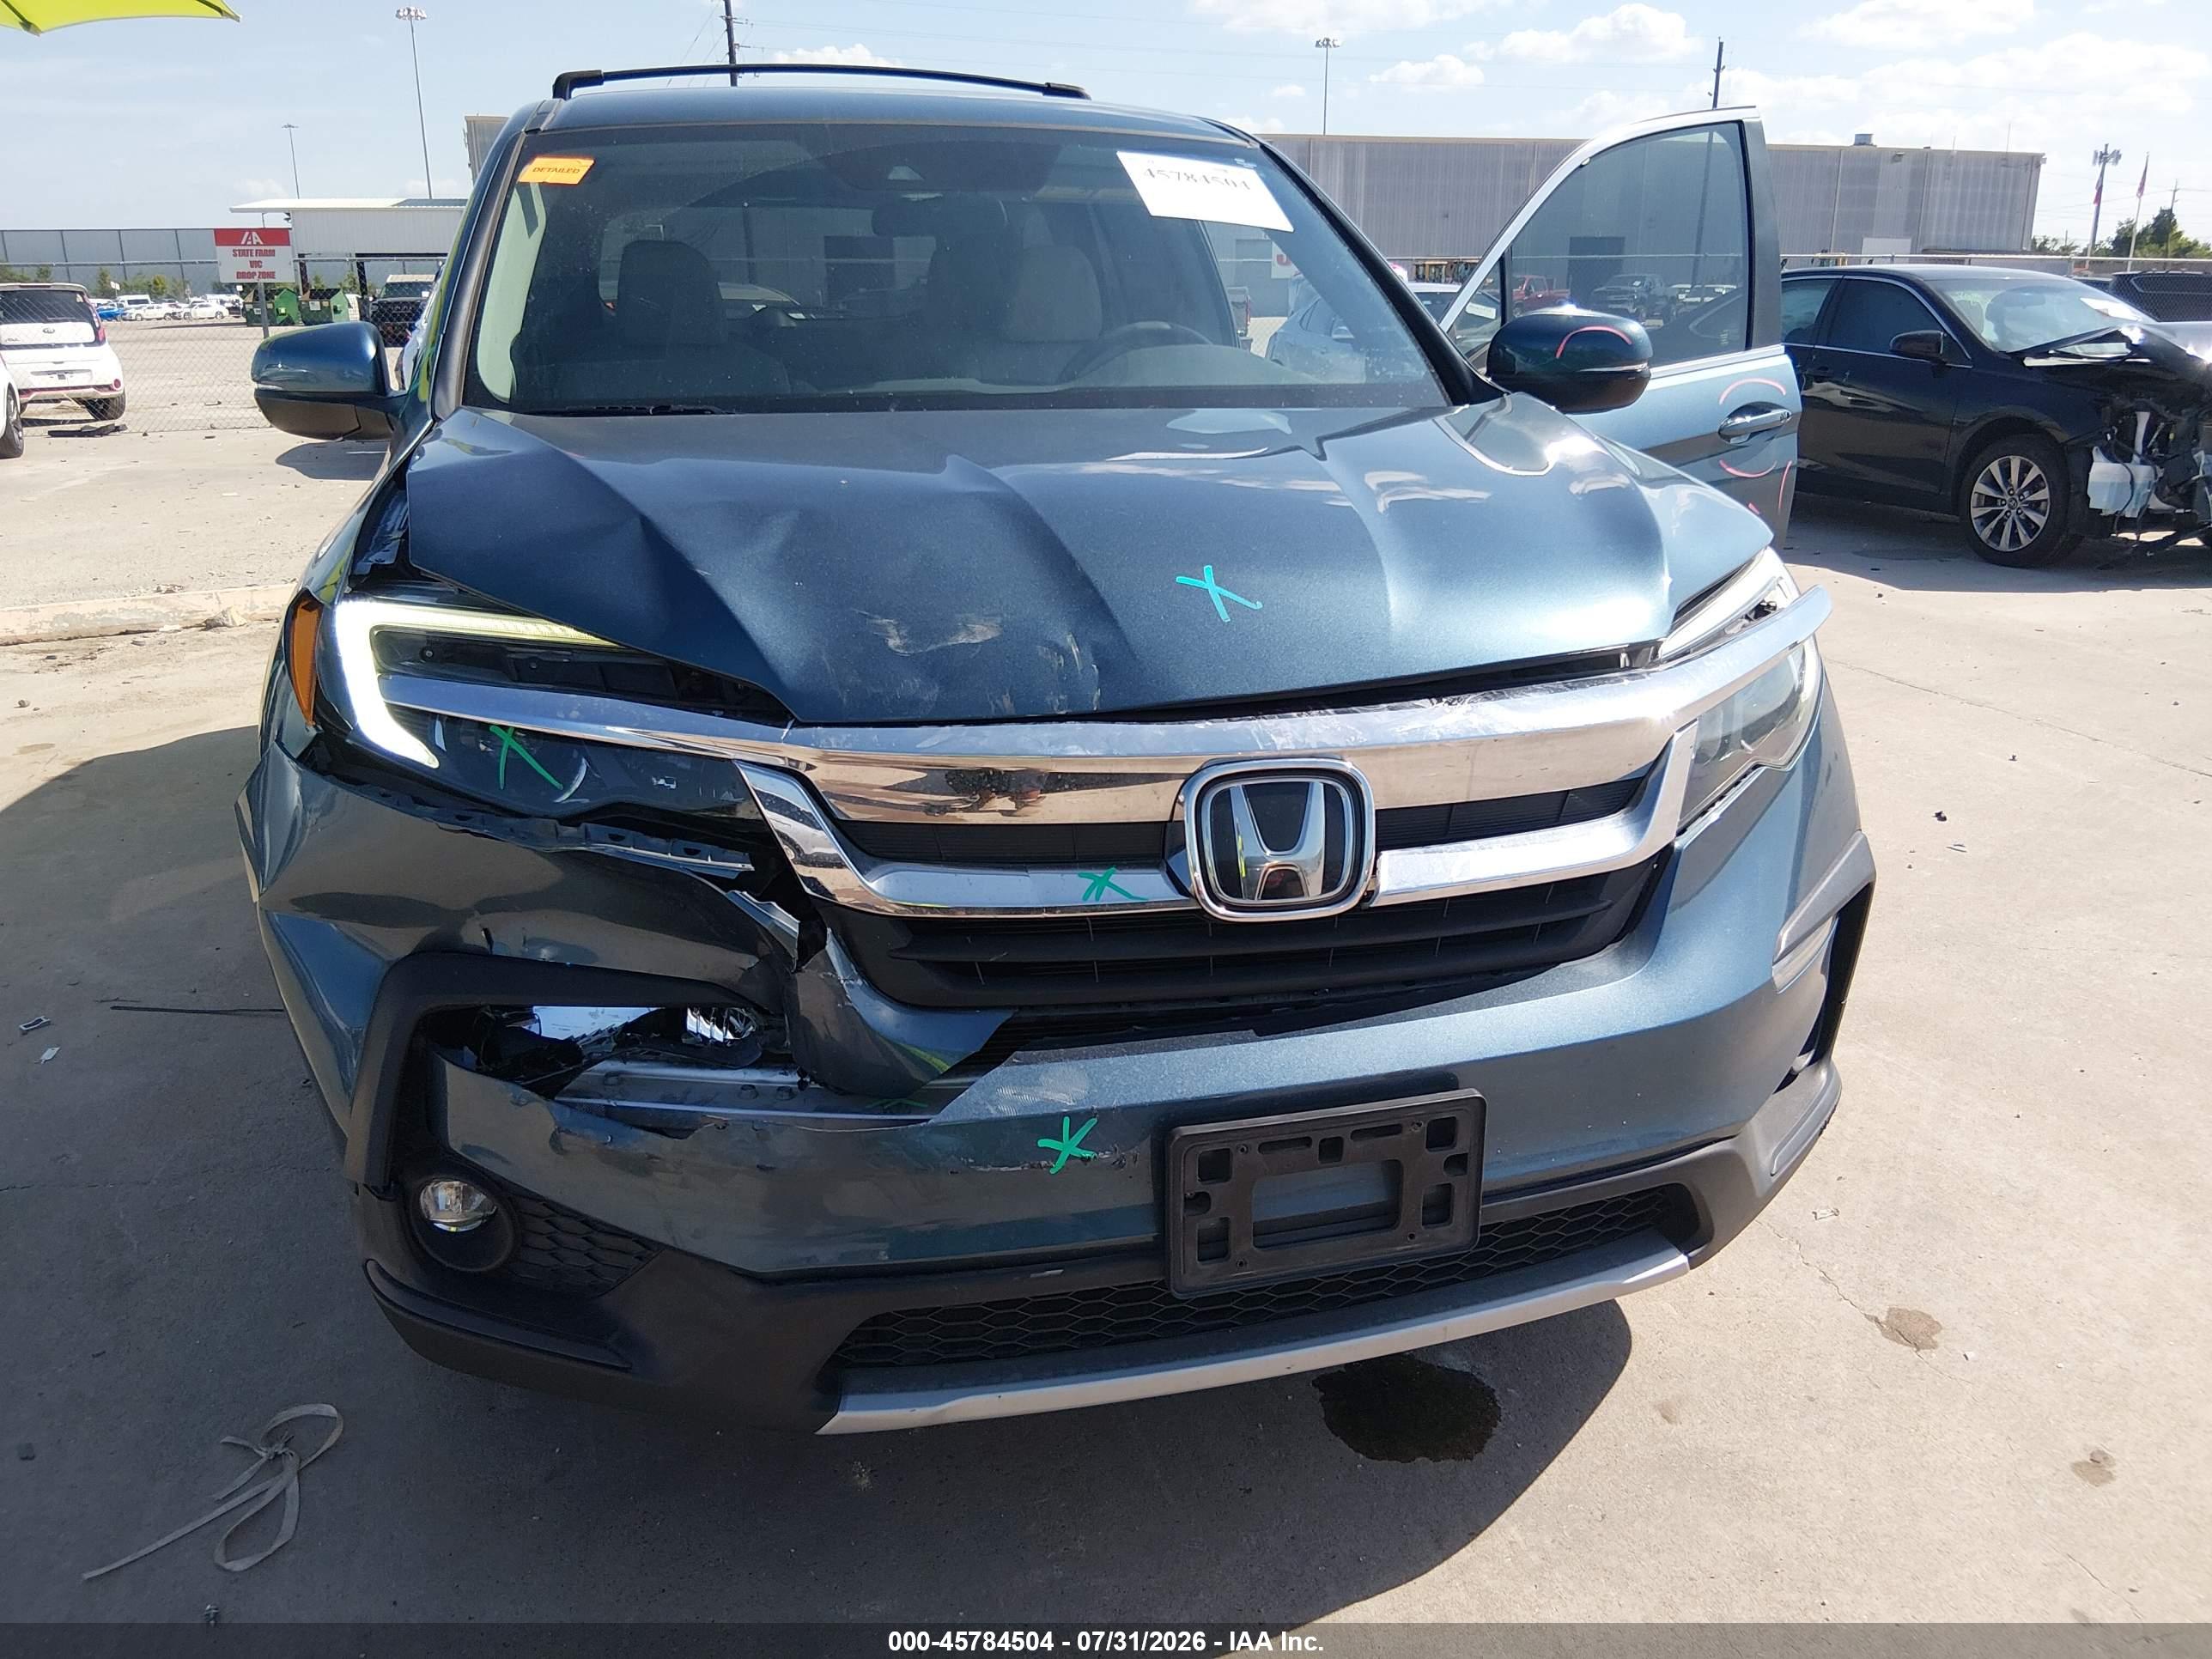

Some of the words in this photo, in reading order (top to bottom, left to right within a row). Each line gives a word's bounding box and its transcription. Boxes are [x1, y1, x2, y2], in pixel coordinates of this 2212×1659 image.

[233, 249, 254, 258] STATE
[255, 249, 276, 258] FARM
[249, 260, 263, 269] VIC
